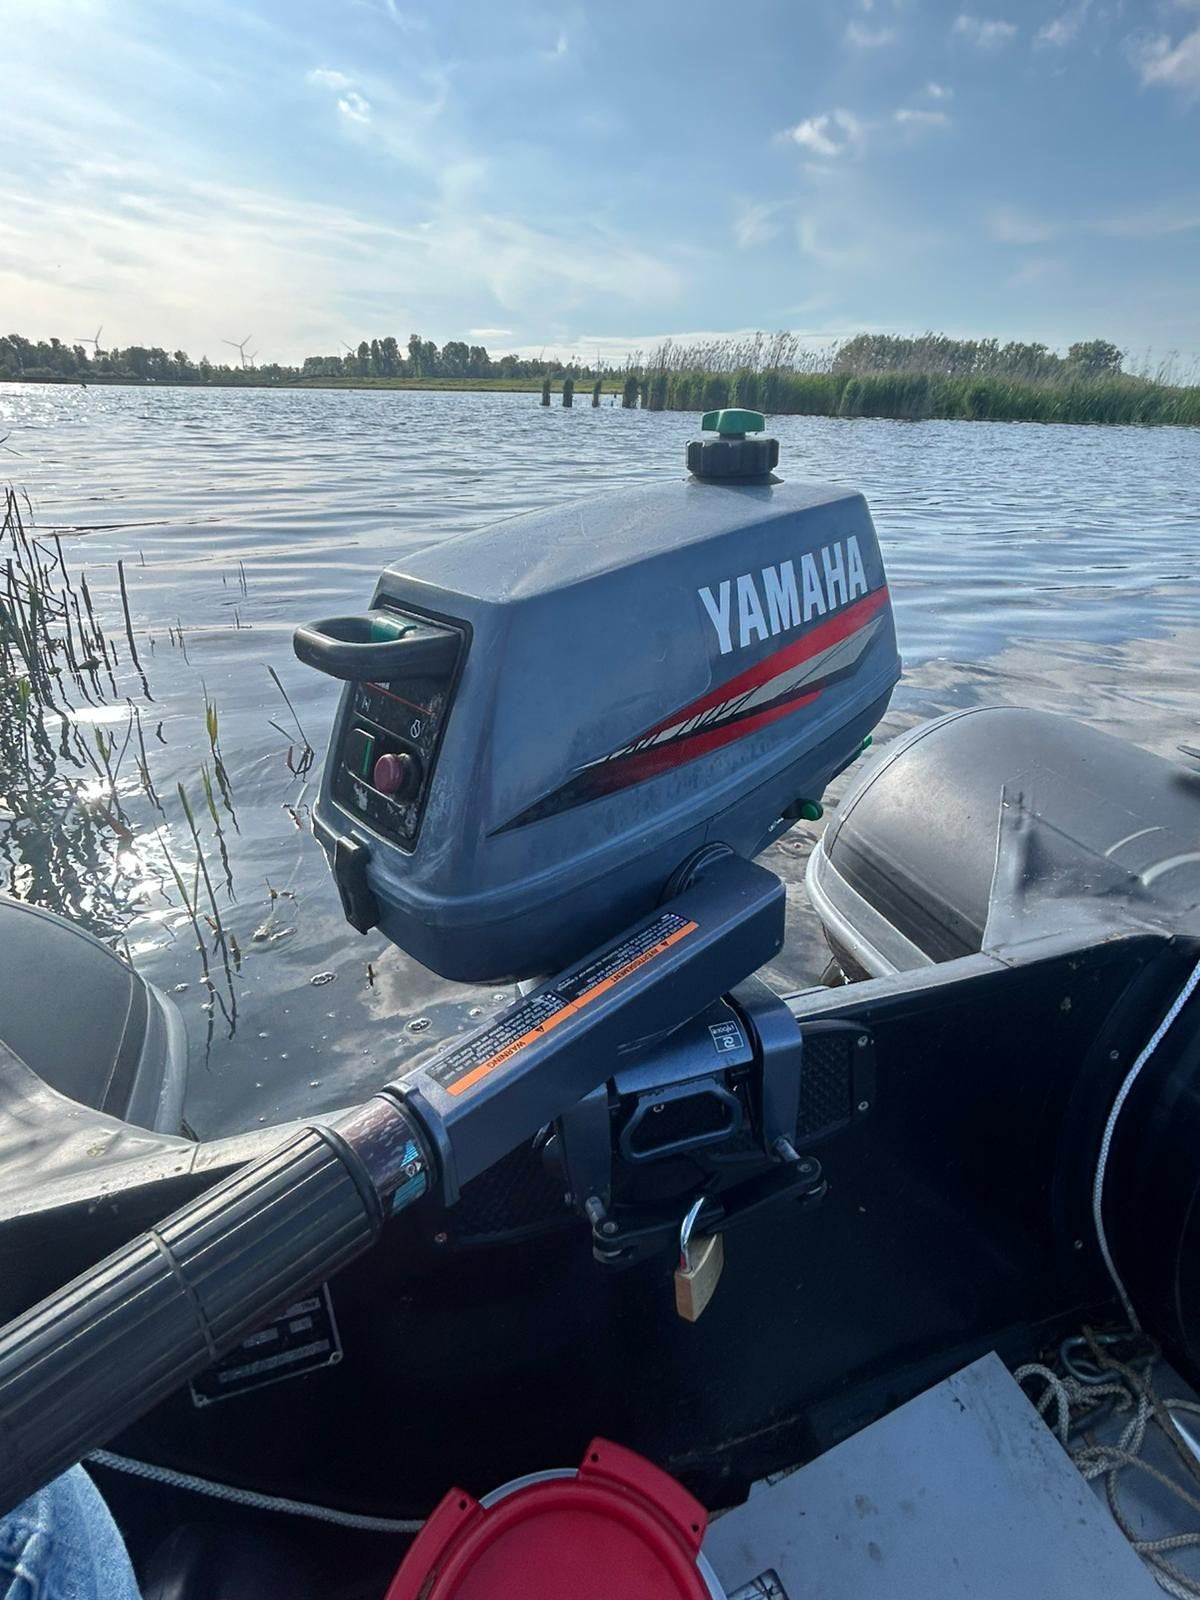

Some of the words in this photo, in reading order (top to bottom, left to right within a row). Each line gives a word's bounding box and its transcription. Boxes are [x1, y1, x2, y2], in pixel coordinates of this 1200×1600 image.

[698, 535, 868, 655] YAMAHA
[608, 947, 660, 983] AVERTISSEMENT
[484, 1038, 527, 1070] WARNING
